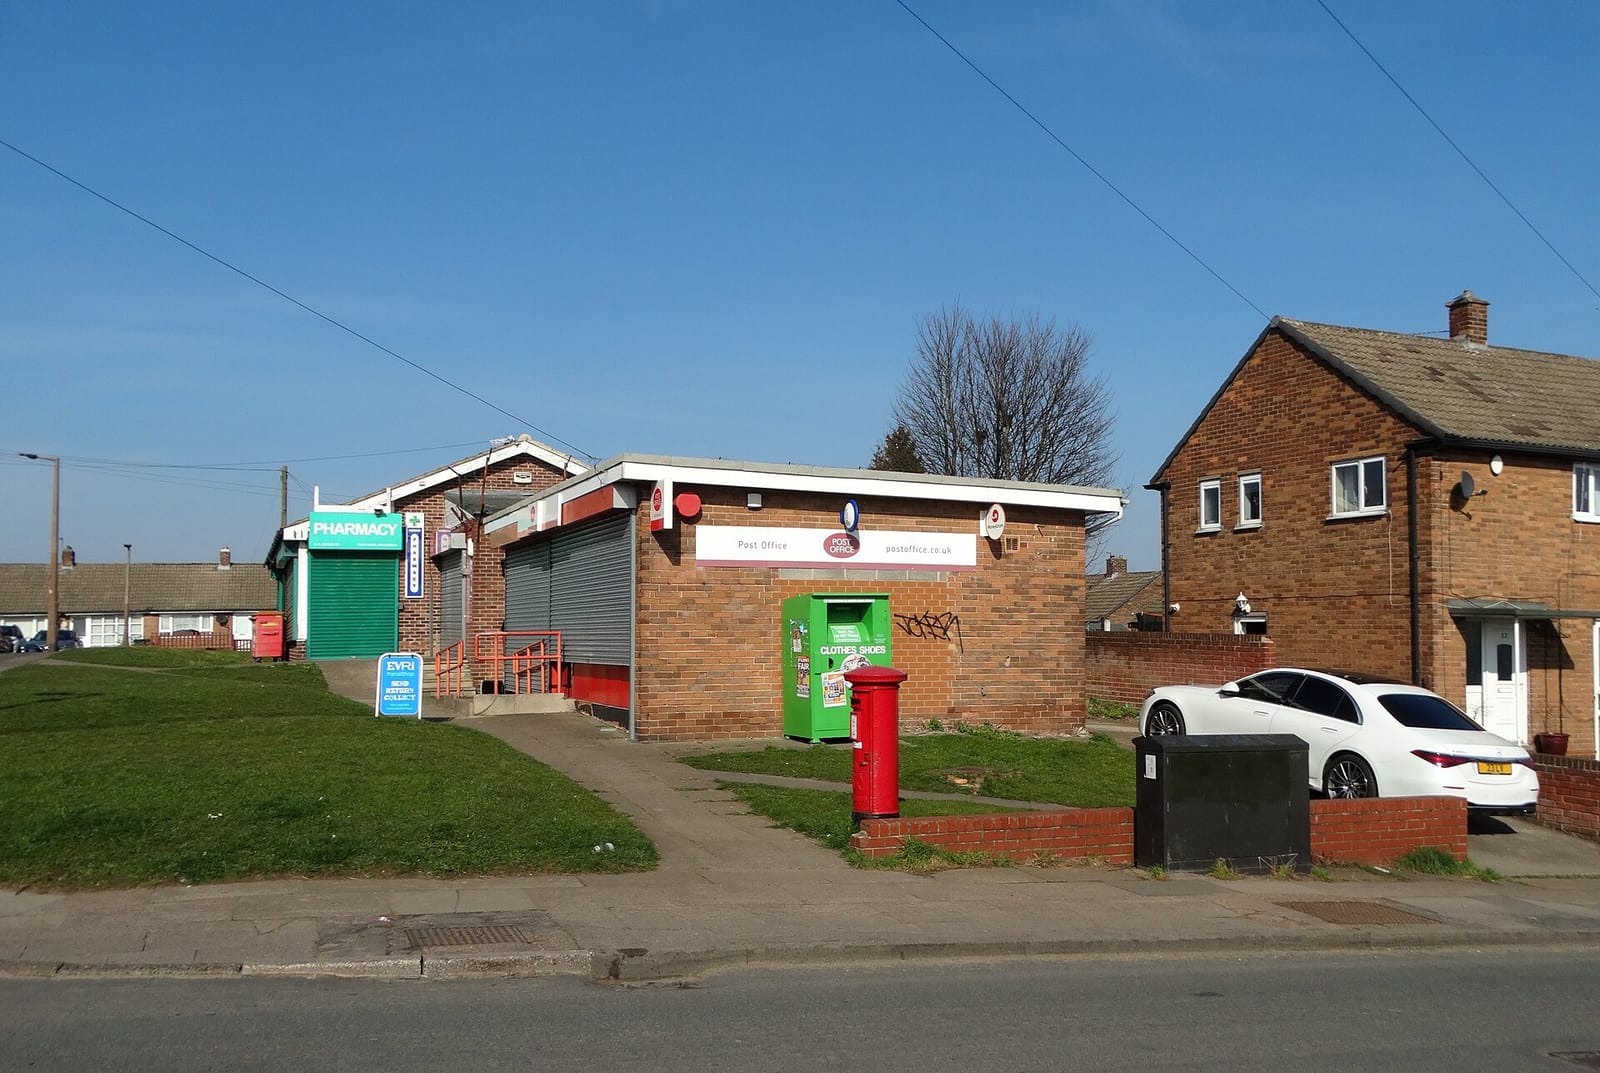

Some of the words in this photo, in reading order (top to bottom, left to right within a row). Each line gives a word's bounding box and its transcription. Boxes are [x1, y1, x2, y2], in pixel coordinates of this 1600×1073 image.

[313, 522, 398, 536] PHARMACY
[738, 540, 757, 549] Post
[761, 540, 788, 550] Office
[832, 538, 851, 546] POST
[829, 545, 855, 554] OFFICE
[886, 544, 952, 554] postoffice.co.uk
[820, 646, 857, 655] CLOTHES
[860, 645, 886, 654] SHOES
